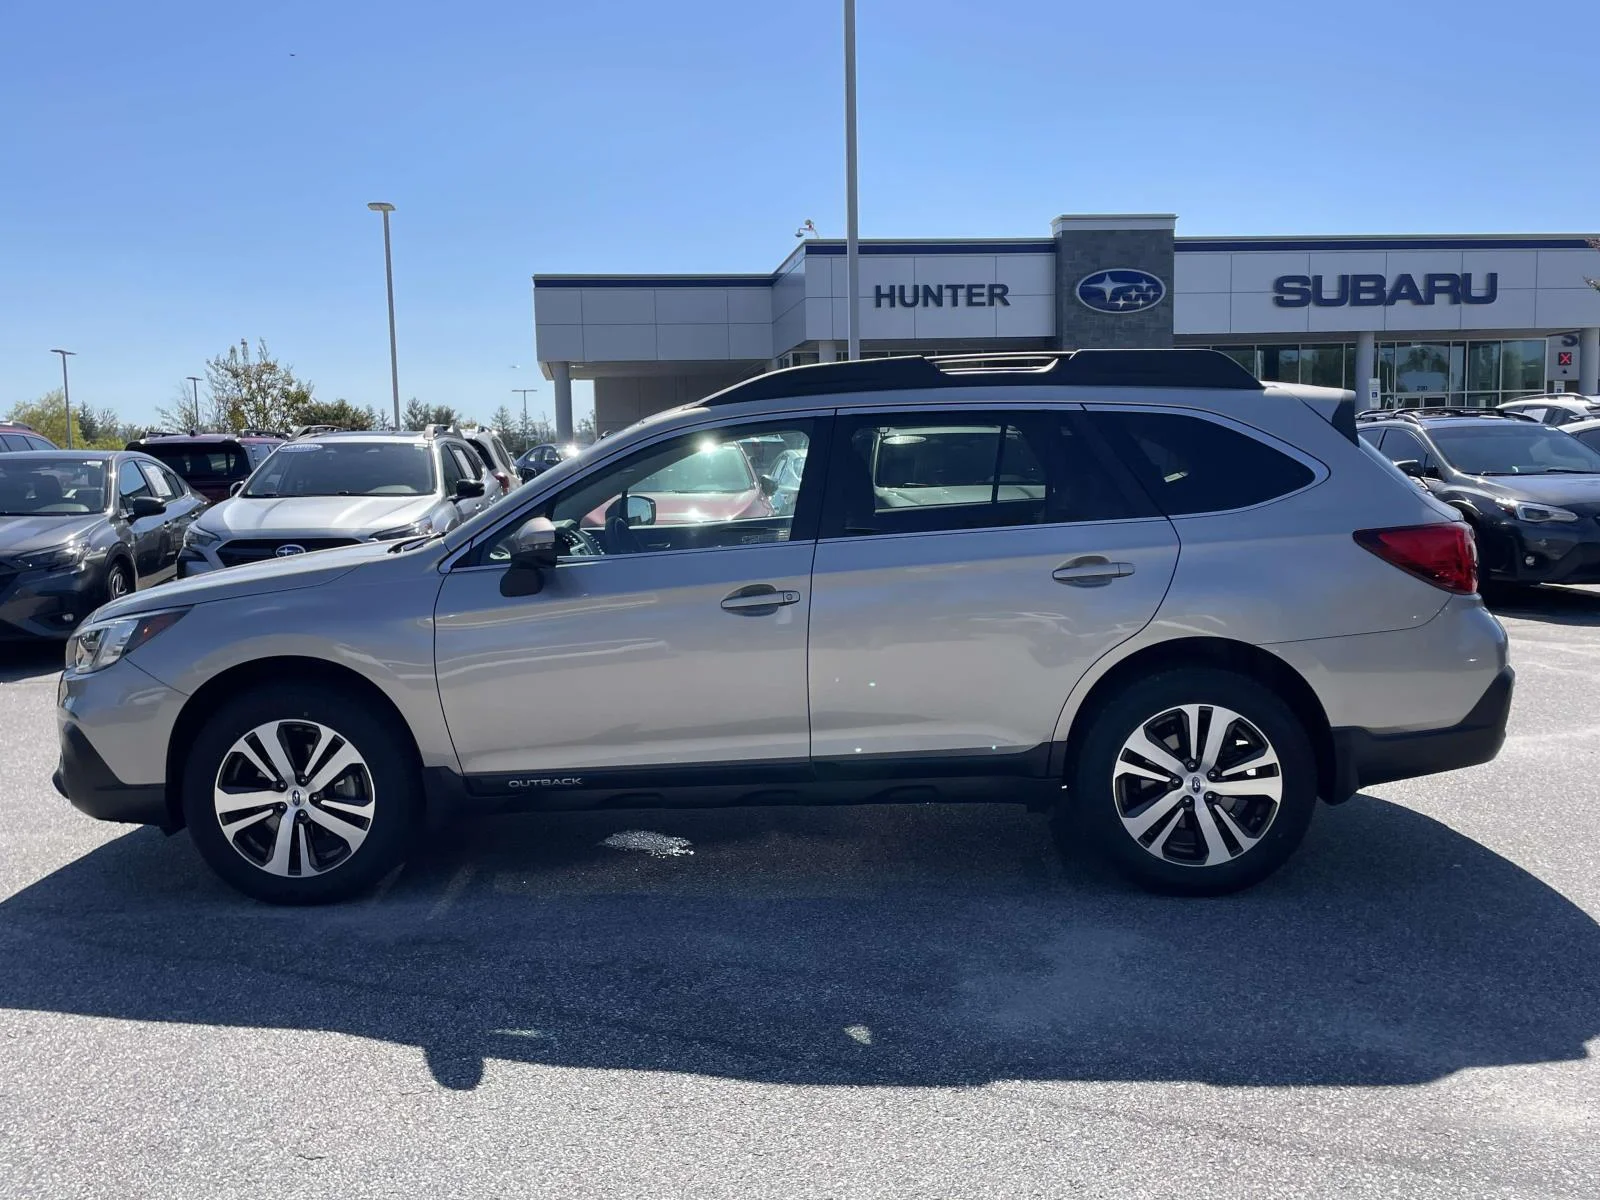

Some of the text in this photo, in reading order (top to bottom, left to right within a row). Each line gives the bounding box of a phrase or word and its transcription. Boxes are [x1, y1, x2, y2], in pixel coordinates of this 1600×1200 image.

[875, 283, 1011, 308] HUNTER
[1273, 272, 1498, 308] SUBARU
[508, 777, 583, 788] OUTBACK
